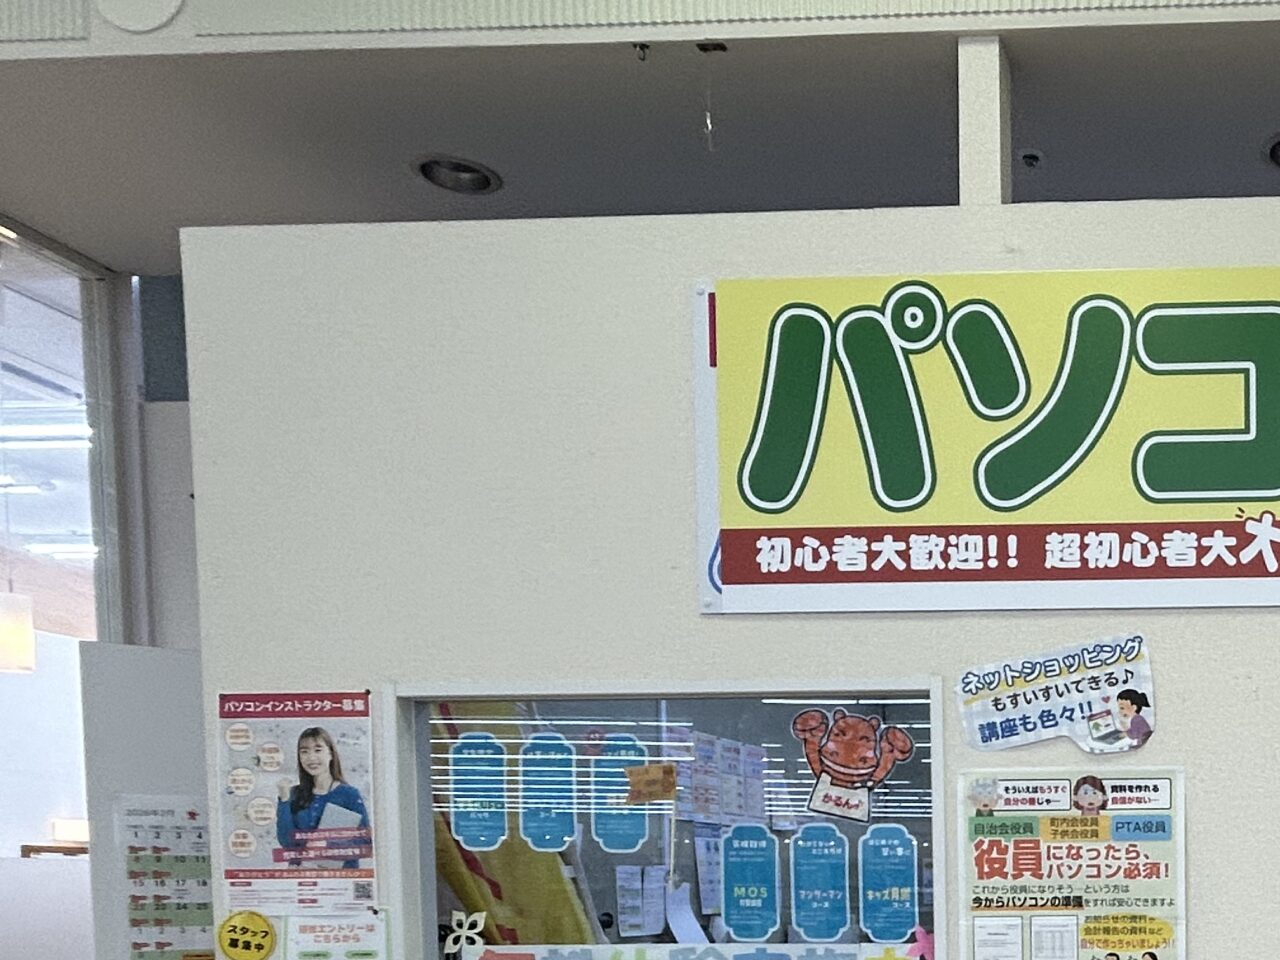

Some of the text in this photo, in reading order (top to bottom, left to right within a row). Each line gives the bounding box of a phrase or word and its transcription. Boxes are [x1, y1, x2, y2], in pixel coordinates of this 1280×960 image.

[755, 533, 1019, 574] 初心者大歓迎!!
[962, 636, 1143, 696] ネットショッピング
[224, 699, 366, 713] パソコンインストラクター募集
[974, 822, 1034, 835] 自治会役員
[1050, 817, 1099, 828] 町内会役員
[1115, 820, 1167, 833] PTA役員
[1050, 828, 1099, 839] 子供会役員
[973, 838, 1043, 880] 役員
[733, 886, 768, 897] MOS
[227, 925, 269, 939] スタッフ
[228, 938, 265, 952] 募集中
